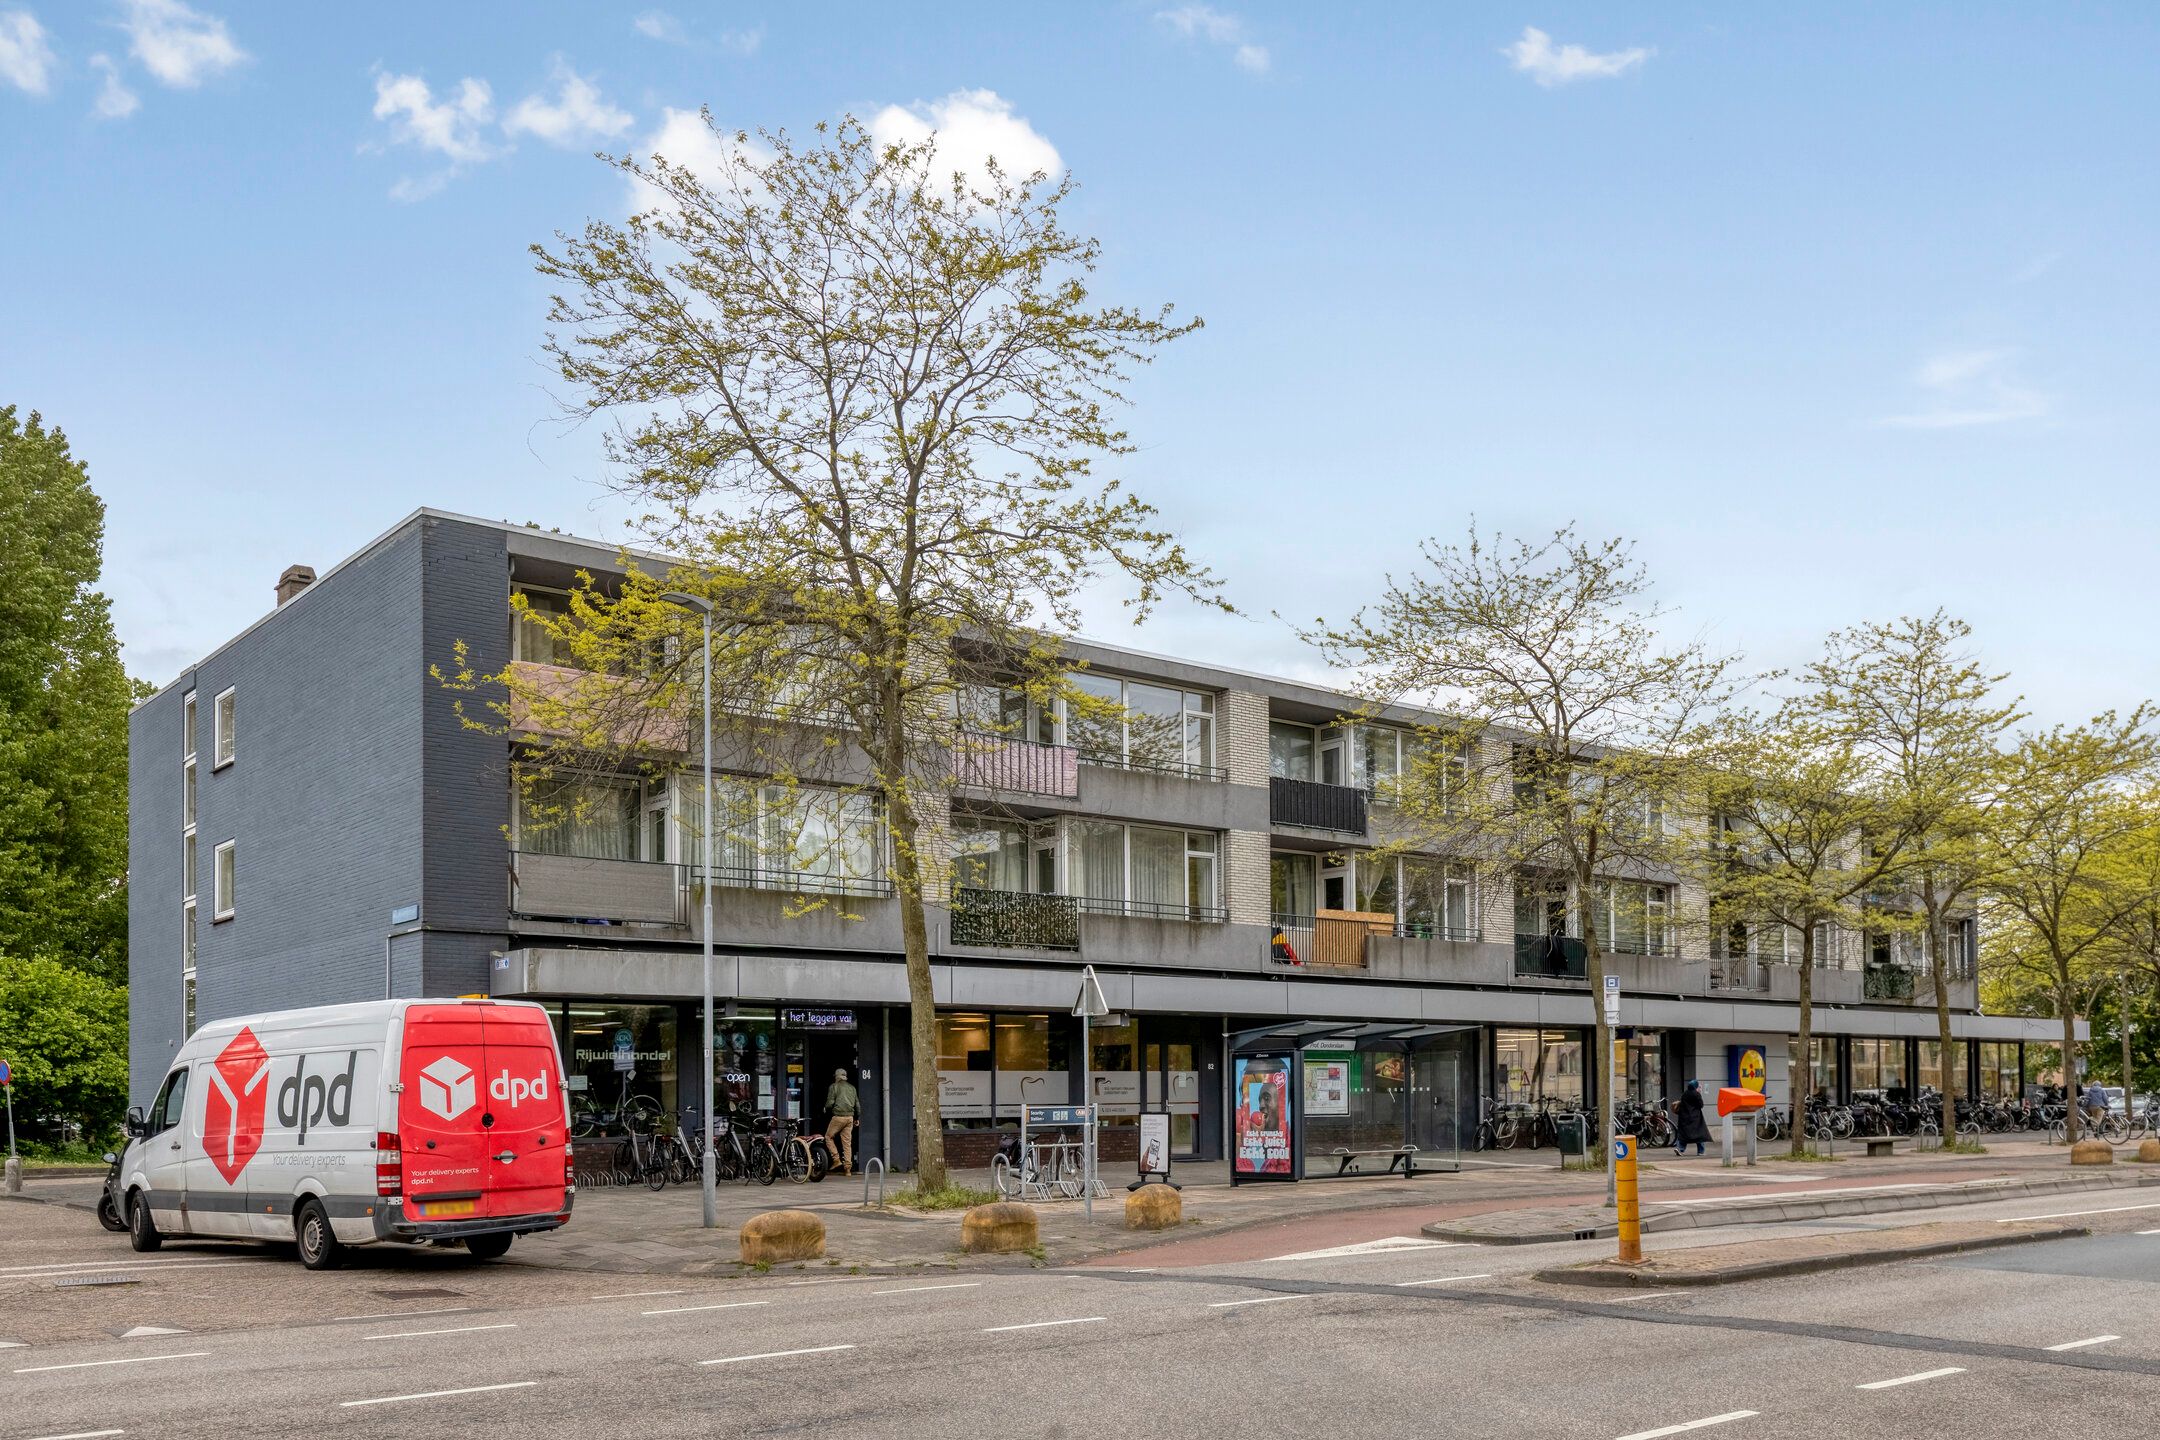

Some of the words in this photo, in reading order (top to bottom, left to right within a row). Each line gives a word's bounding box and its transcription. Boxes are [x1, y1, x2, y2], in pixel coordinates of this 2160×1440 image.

[790, 1011, 805, 1022] het
[808, 1011, 836, 1026] leggen
[575, 1049, 671, 1063] Rijwielhandel
[726, 1073, 751, 1084] open
[862, 1069, 871, 1080] 84
[490, 1069, 548, 1108] dpd
[278, 1050, 357, 1146] dpd
[1243, 1137, 1263, 1147] Echt
[1263, 1136, 1286, 1149] juicy
[1239, 1146, 1266, 1159] Echt
[1266, 1147, 1290, 1160] cool
[272, 1153, 288, 1166] Your
[288, 1153, 316, 1169] delivery
[317, 1154, 346, 1169] experts
[428, 1168, 455, 1176] delivery
[455, 1167, 479, 1175] experts
[411, 1177, 434, 1186] dpd.nl
